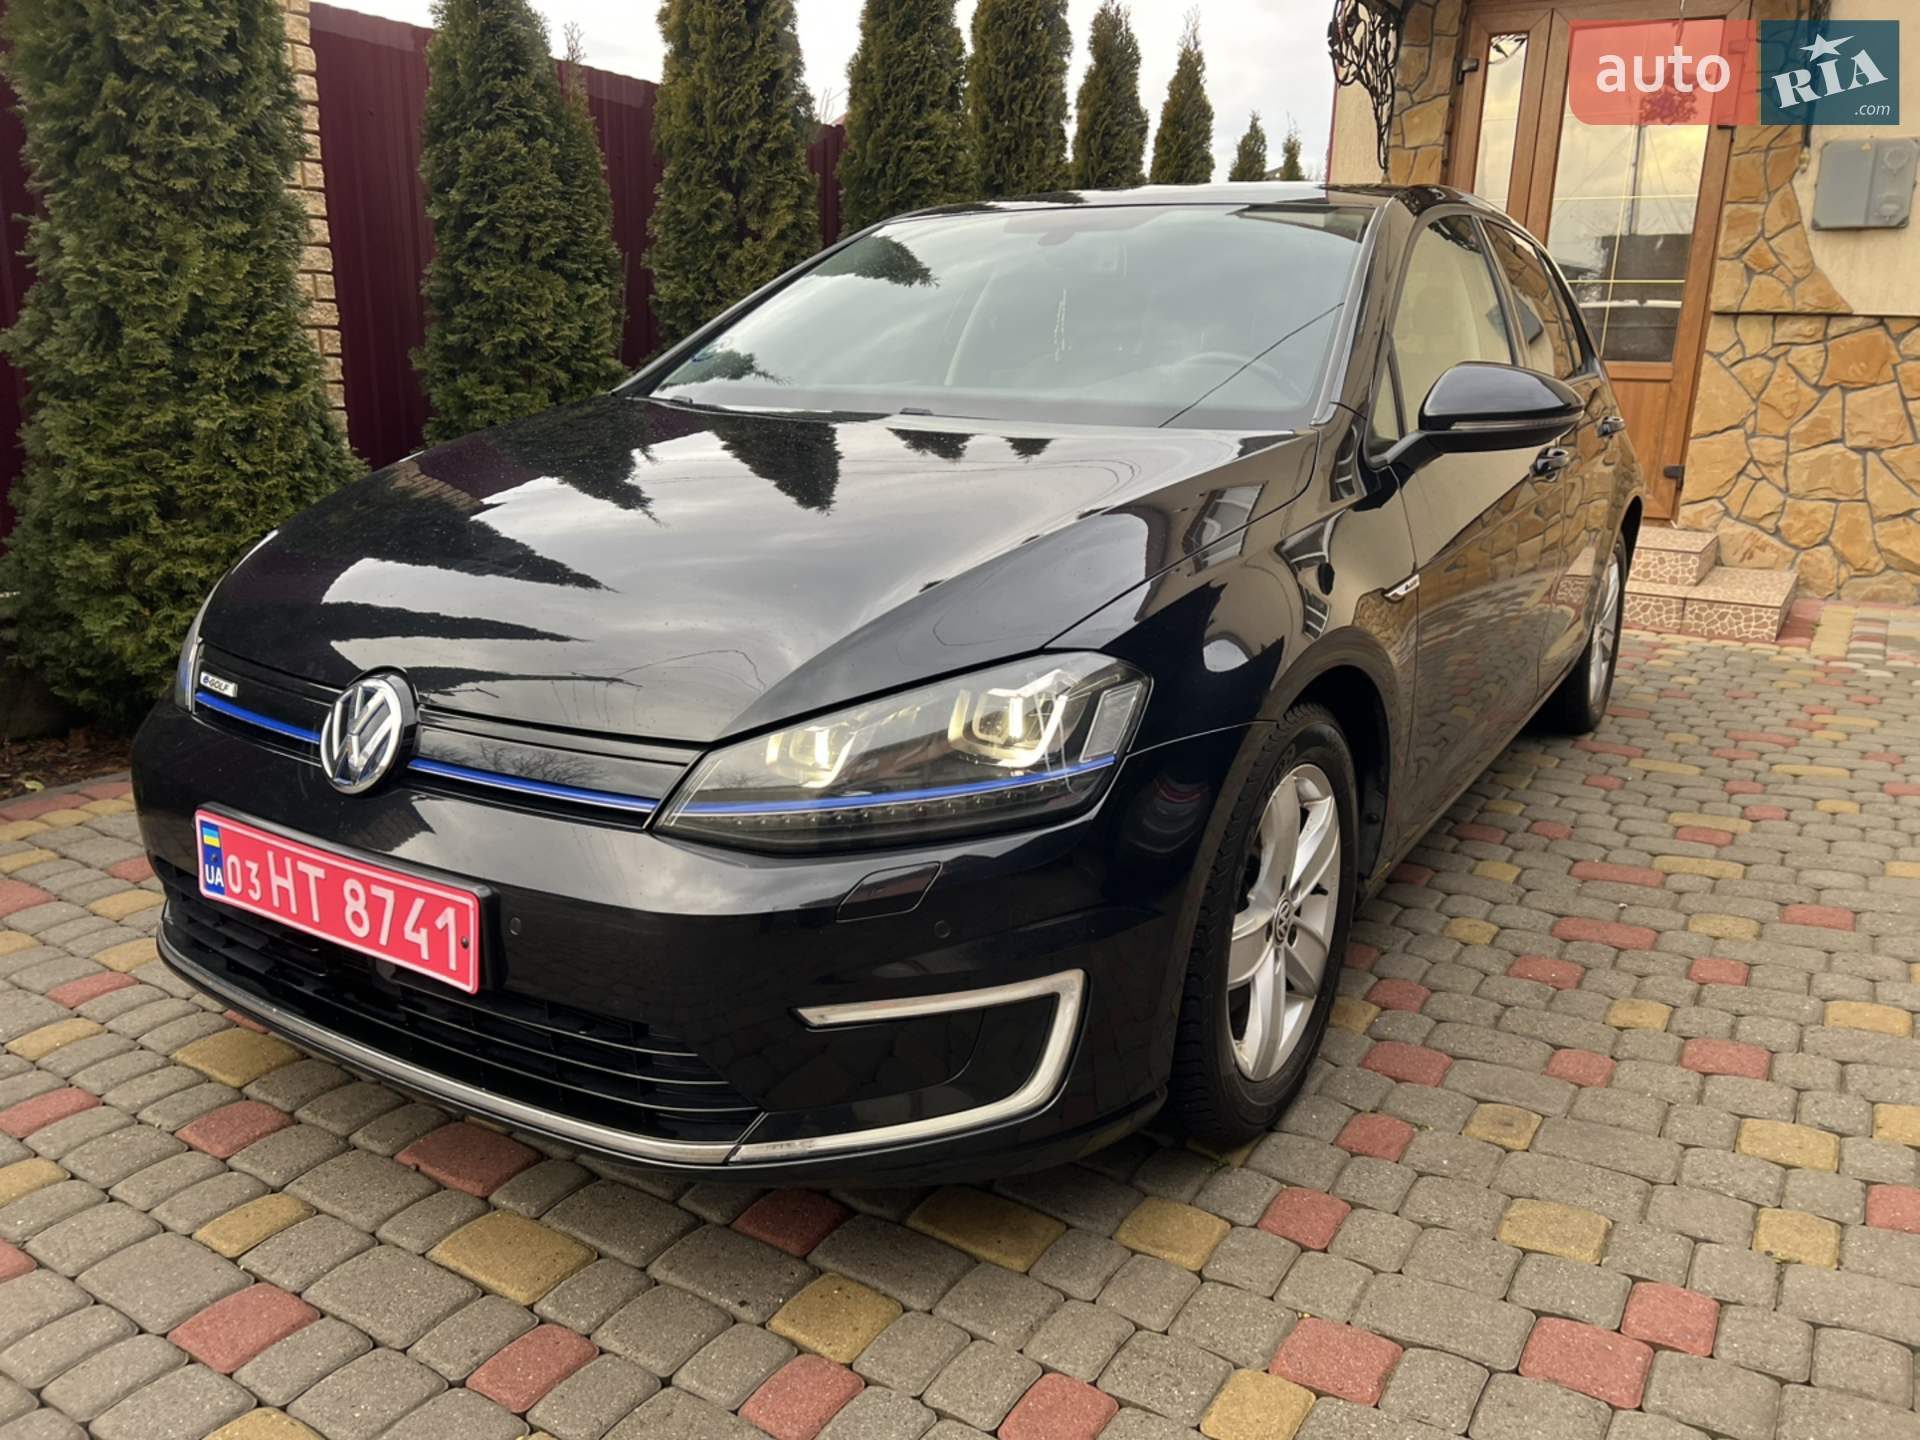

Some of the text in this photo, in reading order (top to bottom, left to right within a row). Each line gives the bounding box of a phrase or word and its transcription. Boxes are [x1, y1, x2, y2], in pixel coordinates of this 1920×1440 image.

[205, 864, 224, 888] UA
[226, 850, 458, 972] 03 HT 8741
